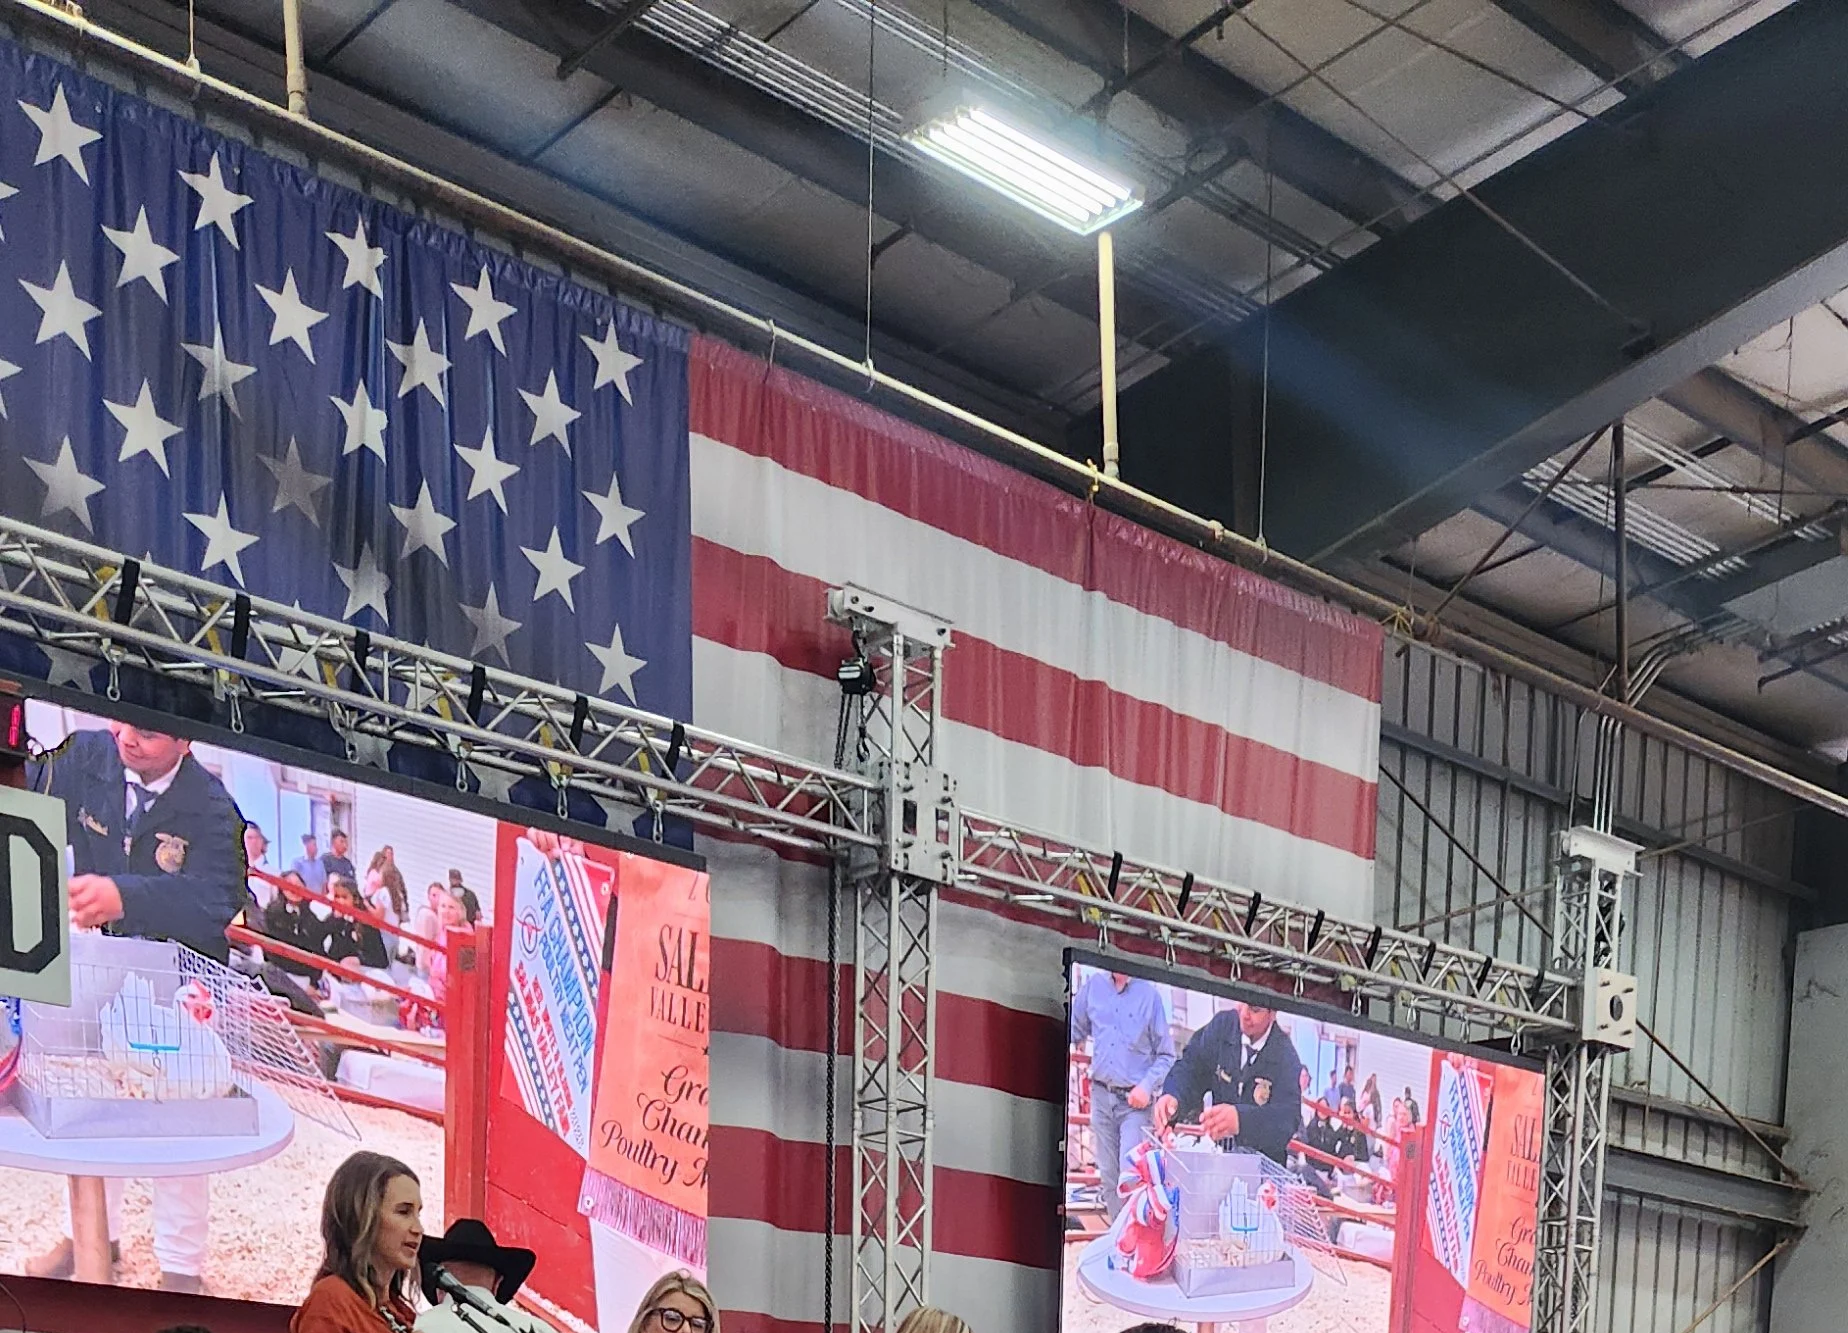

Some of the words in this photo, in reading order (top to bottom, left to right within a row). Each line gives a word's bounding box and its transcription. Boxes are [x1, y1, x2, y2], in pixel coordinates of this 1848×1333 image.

[534, 861, 554, 922] FFA
[549, 911, 594, 1056] CHAMPION
[655, 924, 708, 994] SAL
[601, 1120, 678, 1185] Poultry
[1511, 1114, 1538, 1163] SAL
[1475, 1260, 1515, 1305] Poultry
